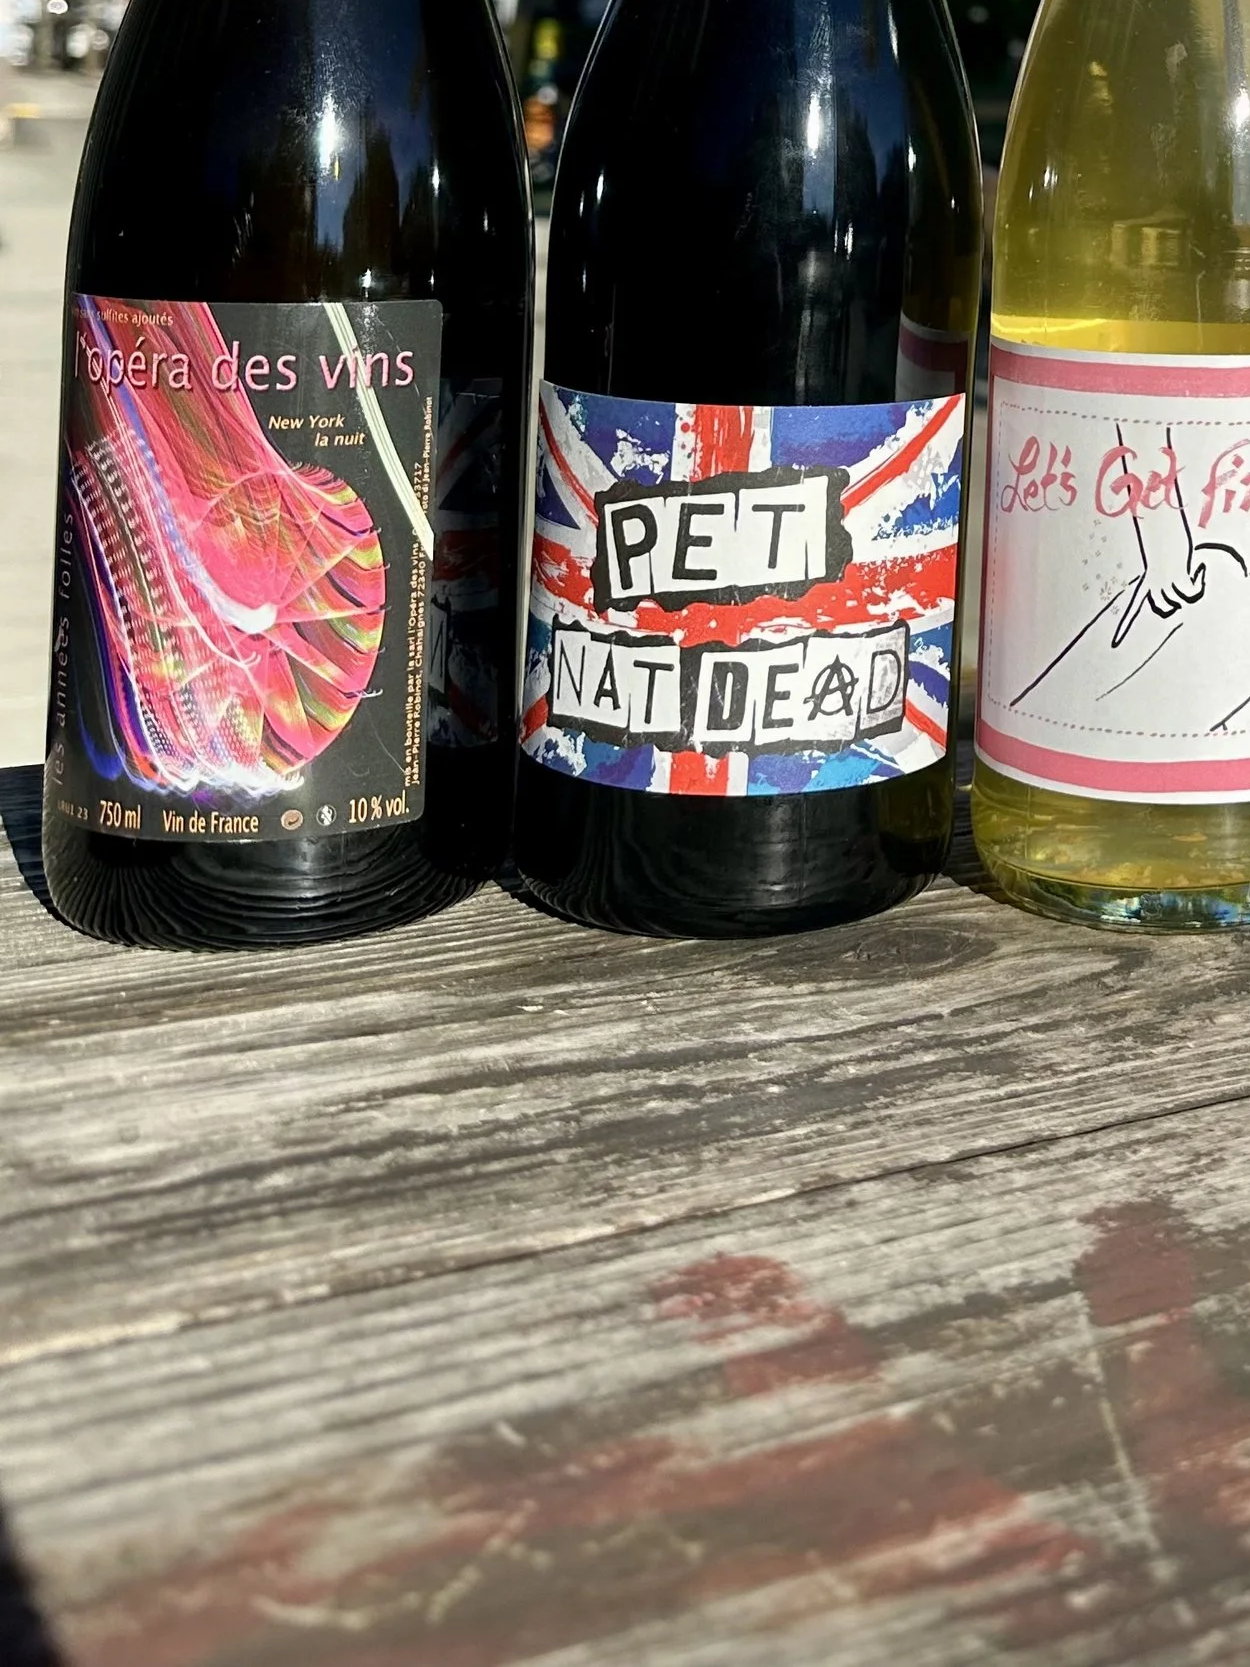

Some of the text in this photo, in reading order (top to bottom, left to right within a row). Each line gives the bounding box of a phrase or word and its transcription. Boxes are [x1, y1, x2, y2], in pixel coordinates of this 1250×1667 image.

[97, 307, 129, 324] sulfites
[131, 310, 174, 327] ajoutés
[74, 331, 416, 395] l'opéra des vins
[268, 413, 346, 430] New York
[315, 432, 366, 447] la nuit
[422, 433, 430, 482] Jean-Pierre
[1001, 436, 1077, 513] Let's
[1095, 445, 1189, 520] Get
[610, 502, 806, 591] PET
[410, 568, 418, 588] des
[418, 561, 426, 598] 72340
[52, 743, 65, 785] les
[60, 513, 74, 598] folles
[414, 602, 425, 666] Chahaignes
[407, 660, 414, 671] la
[556, 639, 902, 731] NAT DEAD
[404, 695, 414, 746] bouteille
[405, 748, 412, 762] en
[412, 720, 420, 784] Jean-Pierre
[100, 800, 142, 830] 750 ml
[162, 809, 259, 833] Vin de France
[385, 789, 410, 818] vol.
